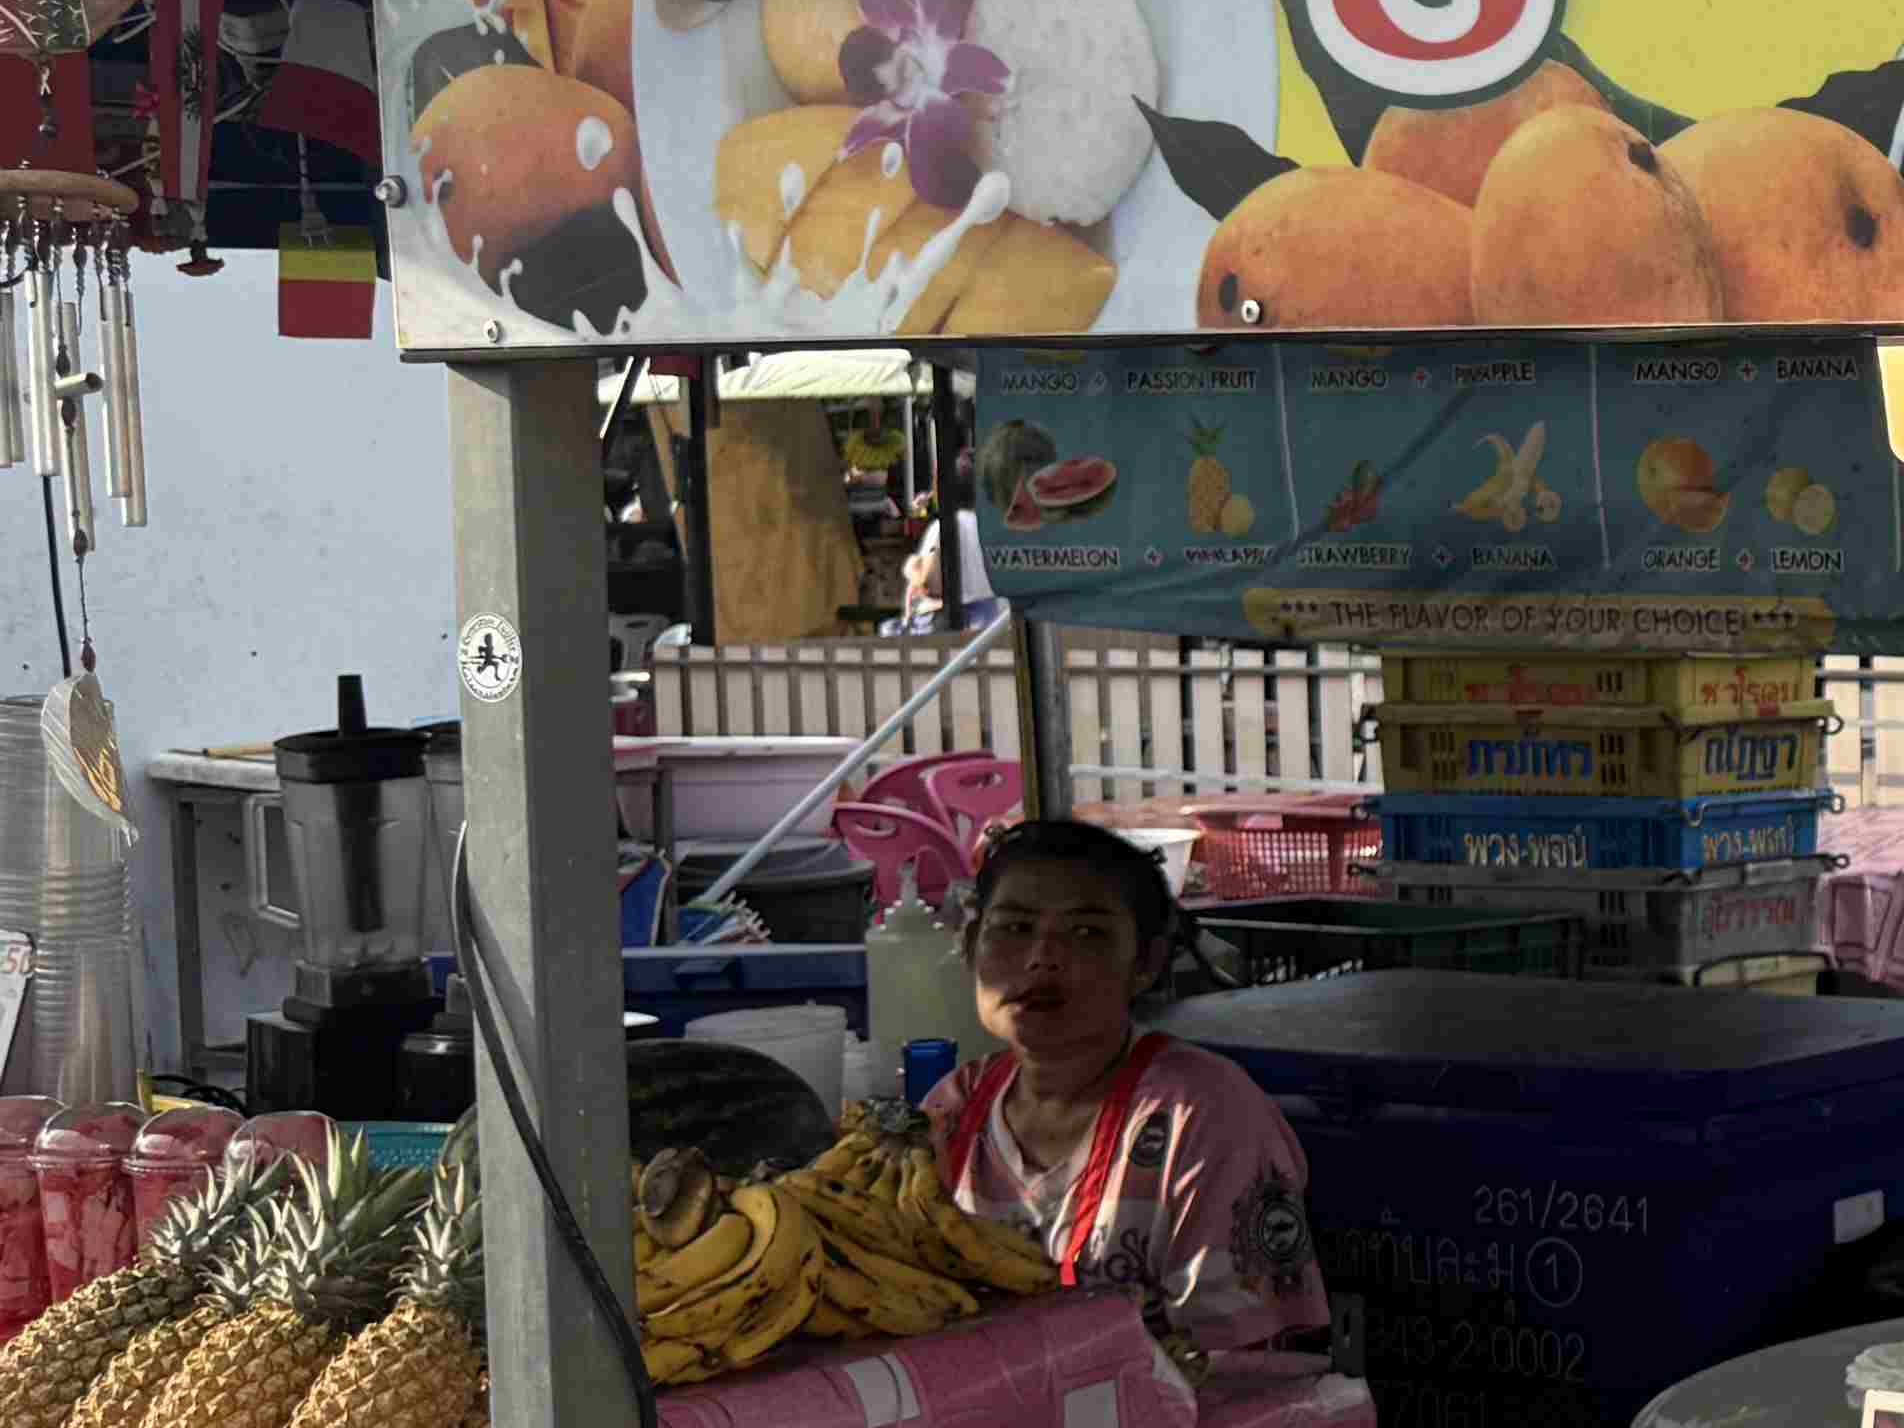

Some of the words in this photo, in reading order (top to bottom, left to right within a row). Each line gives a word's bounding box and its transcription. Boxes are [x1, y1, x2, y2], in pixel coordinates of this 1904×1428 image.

[1311, 368, 1388, 387] MANGO
[1634, 361, 1720, 381] MANGO
[1776, 358, 1858, 380] BANANA
[1001, 371, 1079, 390] MANGO
[1127, 371, 1204, 390] PASSION
[1210, 371, 1257, 389] FRUIT
[989, 548, 1119, 567] WATERMELON
[1472, 547, 1553, 567] BANANA
[1643, 550, 1720, 570] ORANGE
[1772, 550, 1842, 571] LEMON
[1333, 603, 1378, 628] THE
[1390, 605, 1489, 633] FLAVOR
[1503, 607, 1536, 633] OF
[1549, 607, 1624, 634] YOUR
[1472, 1179, 1649, 1236] 261/2641
